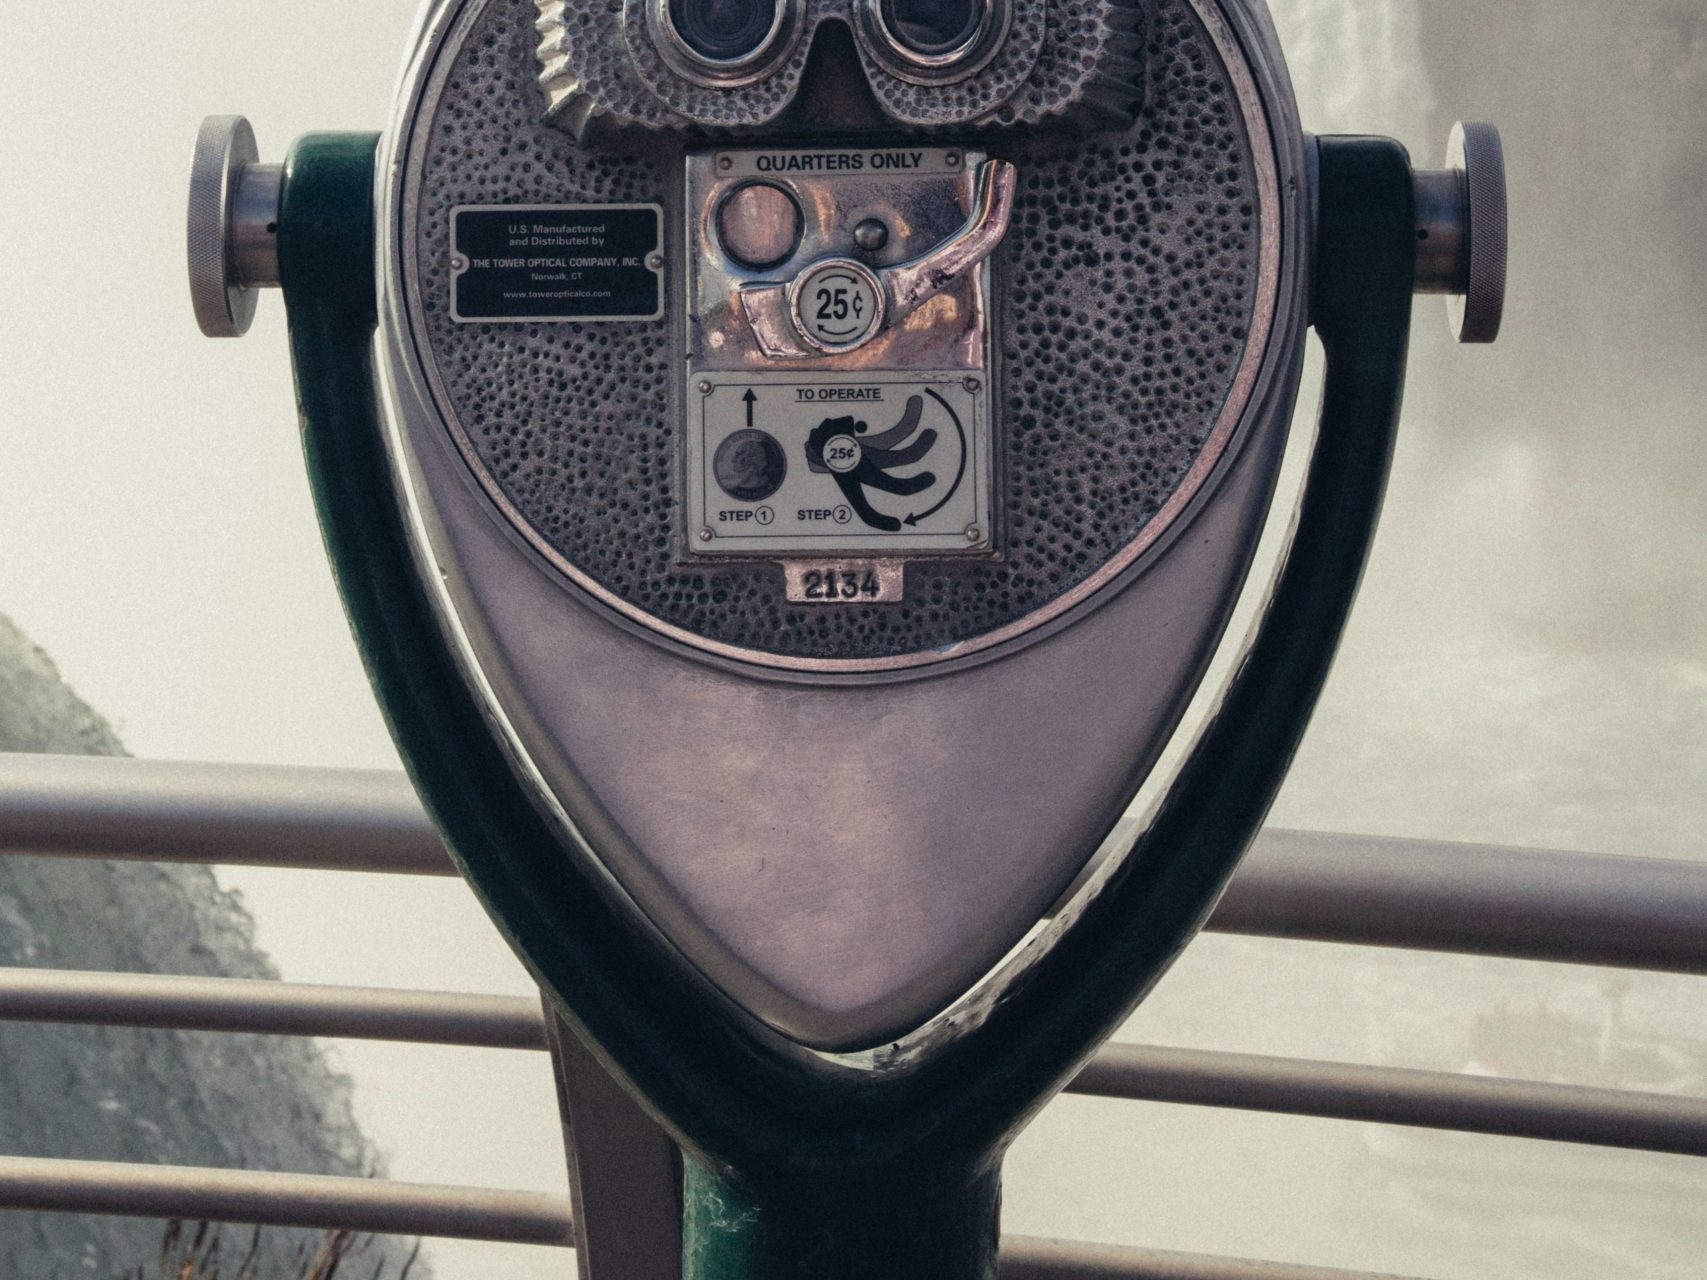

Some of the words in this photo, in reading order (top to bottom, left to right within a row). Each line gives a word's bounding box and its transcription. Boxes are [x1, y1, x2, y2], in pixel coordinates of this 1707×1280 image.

[756, 154, 863, 172] QUARTERS
[871, 153, 922, 169] ONLY
[508, 225, 530, 234] U.S.
[533, 224, 605, 234] Manufactured
[509, 237, 528, 246] and
[531, 236, 589, 245] Distributed
[592, 236, 605, 247] by
[473, 259, 490, 268] THE
[493, 258, 525, 268] TOWER
[527, 258, 567, 267] OPTICAL
[569, 257, 620, 268] COMPANY,
[622, 257, 641, 267] INC.
[531, 273, 569, 281] Norwalk,
[571, 272, 582, 280] CT
[503, 290, 611, 299] www.toweropticalco.com
[796, 388, 815, 400] TO
[818, 388, 881, 399] OPERATE
[829, 446, 855, 460] 25¢
[719, 510, 753, 522] STEP
[797, 509, 832, 521] STEP
[804, 569, 880, 598] 2134
